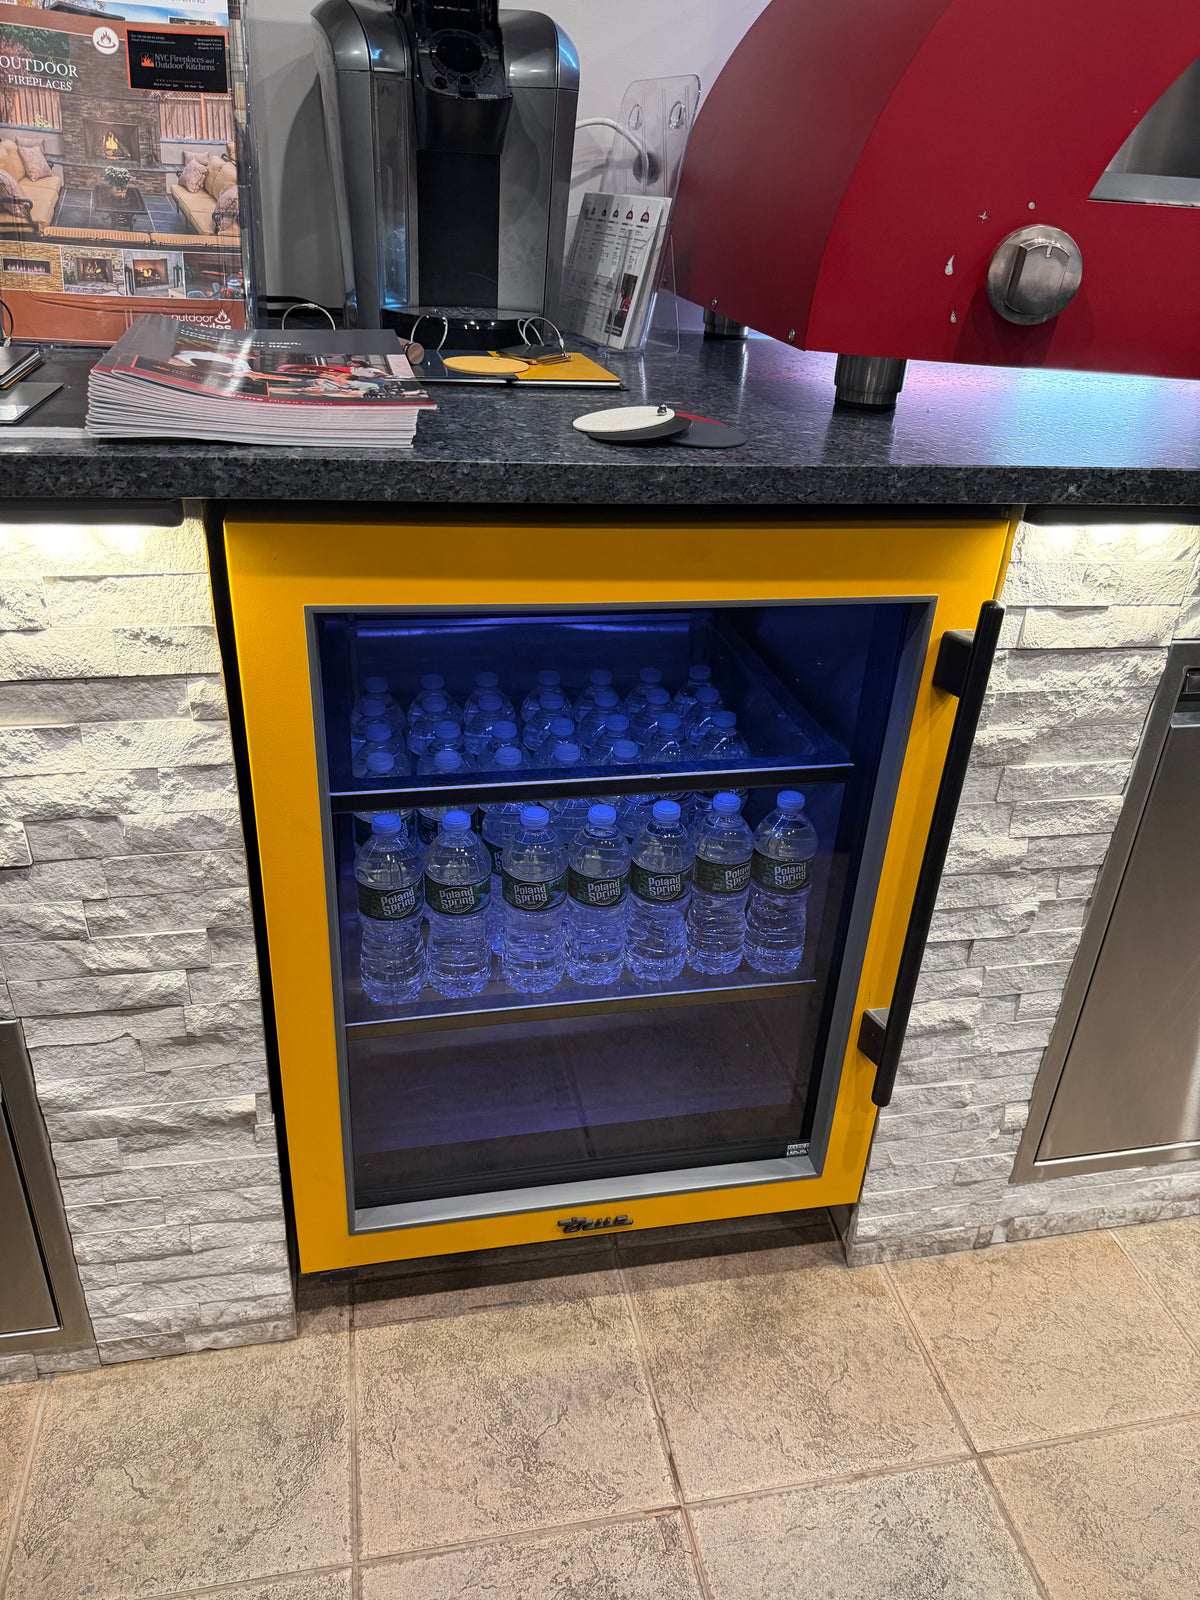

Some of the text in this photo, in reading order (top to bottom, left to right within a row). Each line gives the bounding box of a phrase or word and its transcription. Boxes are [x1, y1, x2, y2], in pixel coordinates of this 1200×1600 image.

[154, 53, 169, 61] NYC
[169, 54, 205, 64] Fireplaces
[155, 61, 216, 71] Outdoor Kitchens
[0, 55, 78, 78] OUTDOOR
[8, 74, 73, 92] FIREPLACES
[774, 862, 807, 877] Poland
[648, 874, 681, 888] Poland
[774, 869, 806, 887] Spring
[439, 886, 474, 901] Poland
[513, 883, 547, 896] Poland
[587, 879, 621, 894] Poland
[648, 882, 681, 897] Spring
[380, 886, 415, 907] Poland
[514, 891, 548, 905] Spring
[588, 886, 621, 903] Spring
[382, 895, 416, 917] Spring
[440, 896, 475, 911] Spring
